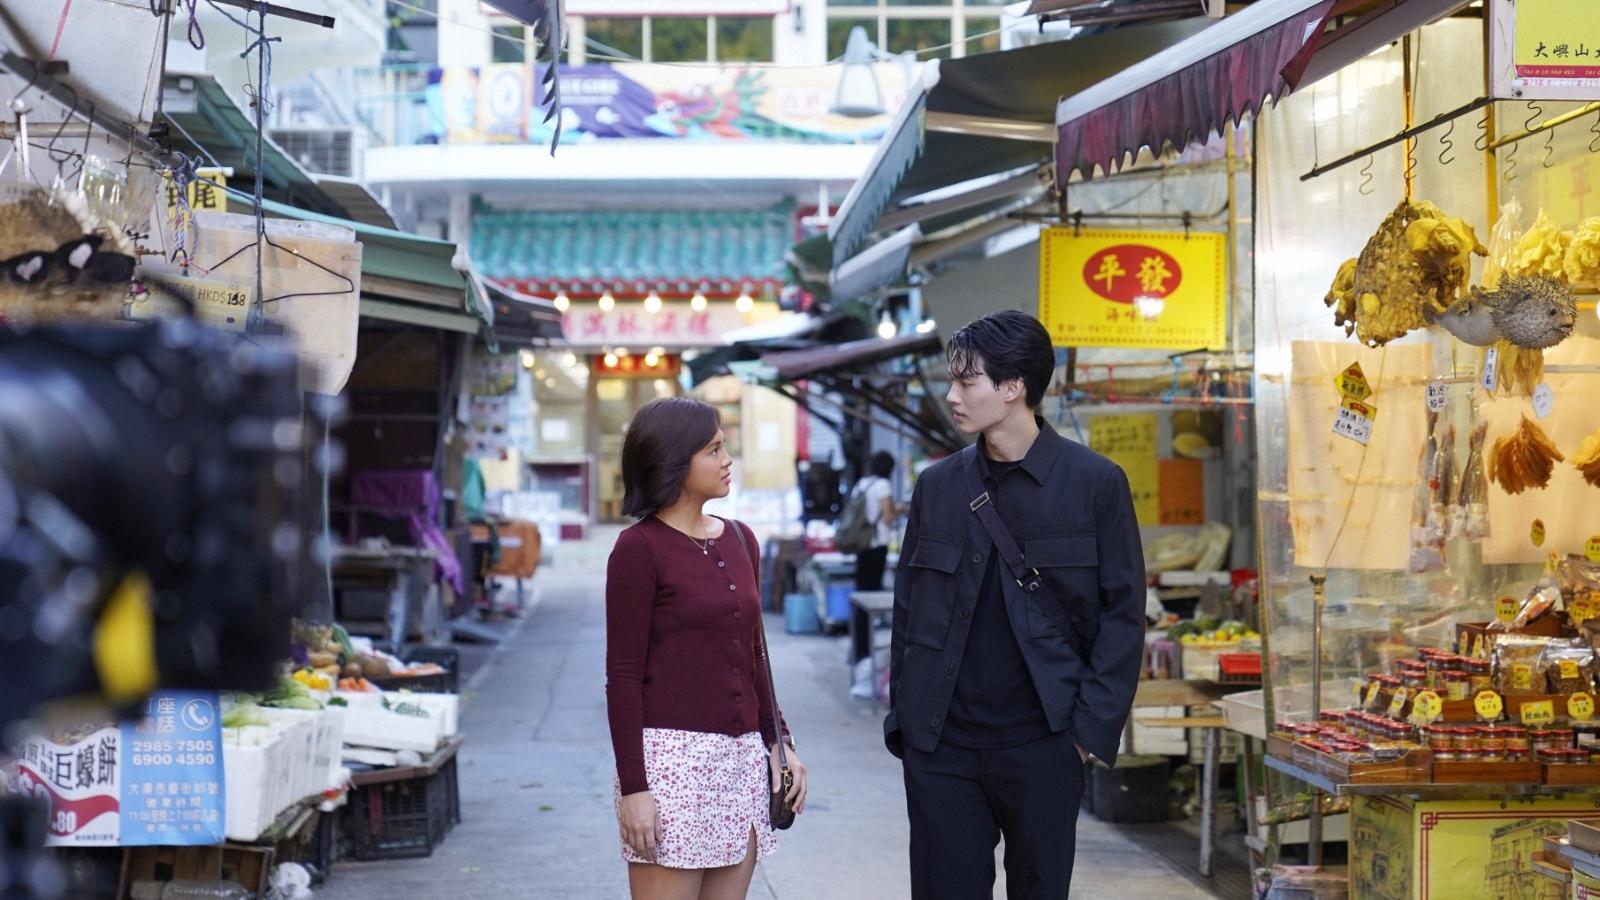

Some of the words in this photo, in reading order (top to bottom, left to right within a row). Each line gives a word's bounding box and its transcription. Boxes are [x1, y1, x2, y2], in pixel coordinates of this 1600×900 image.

[1093, 254, 1173, 294] 平發
[1107, 307, 1158, 323] 海味
[133, 740, 173, 753] 2985
[177, 740, 215, 752] 7505
[132, 753, 173, 766] 6900
[176, 753, 215, 766] 4590
